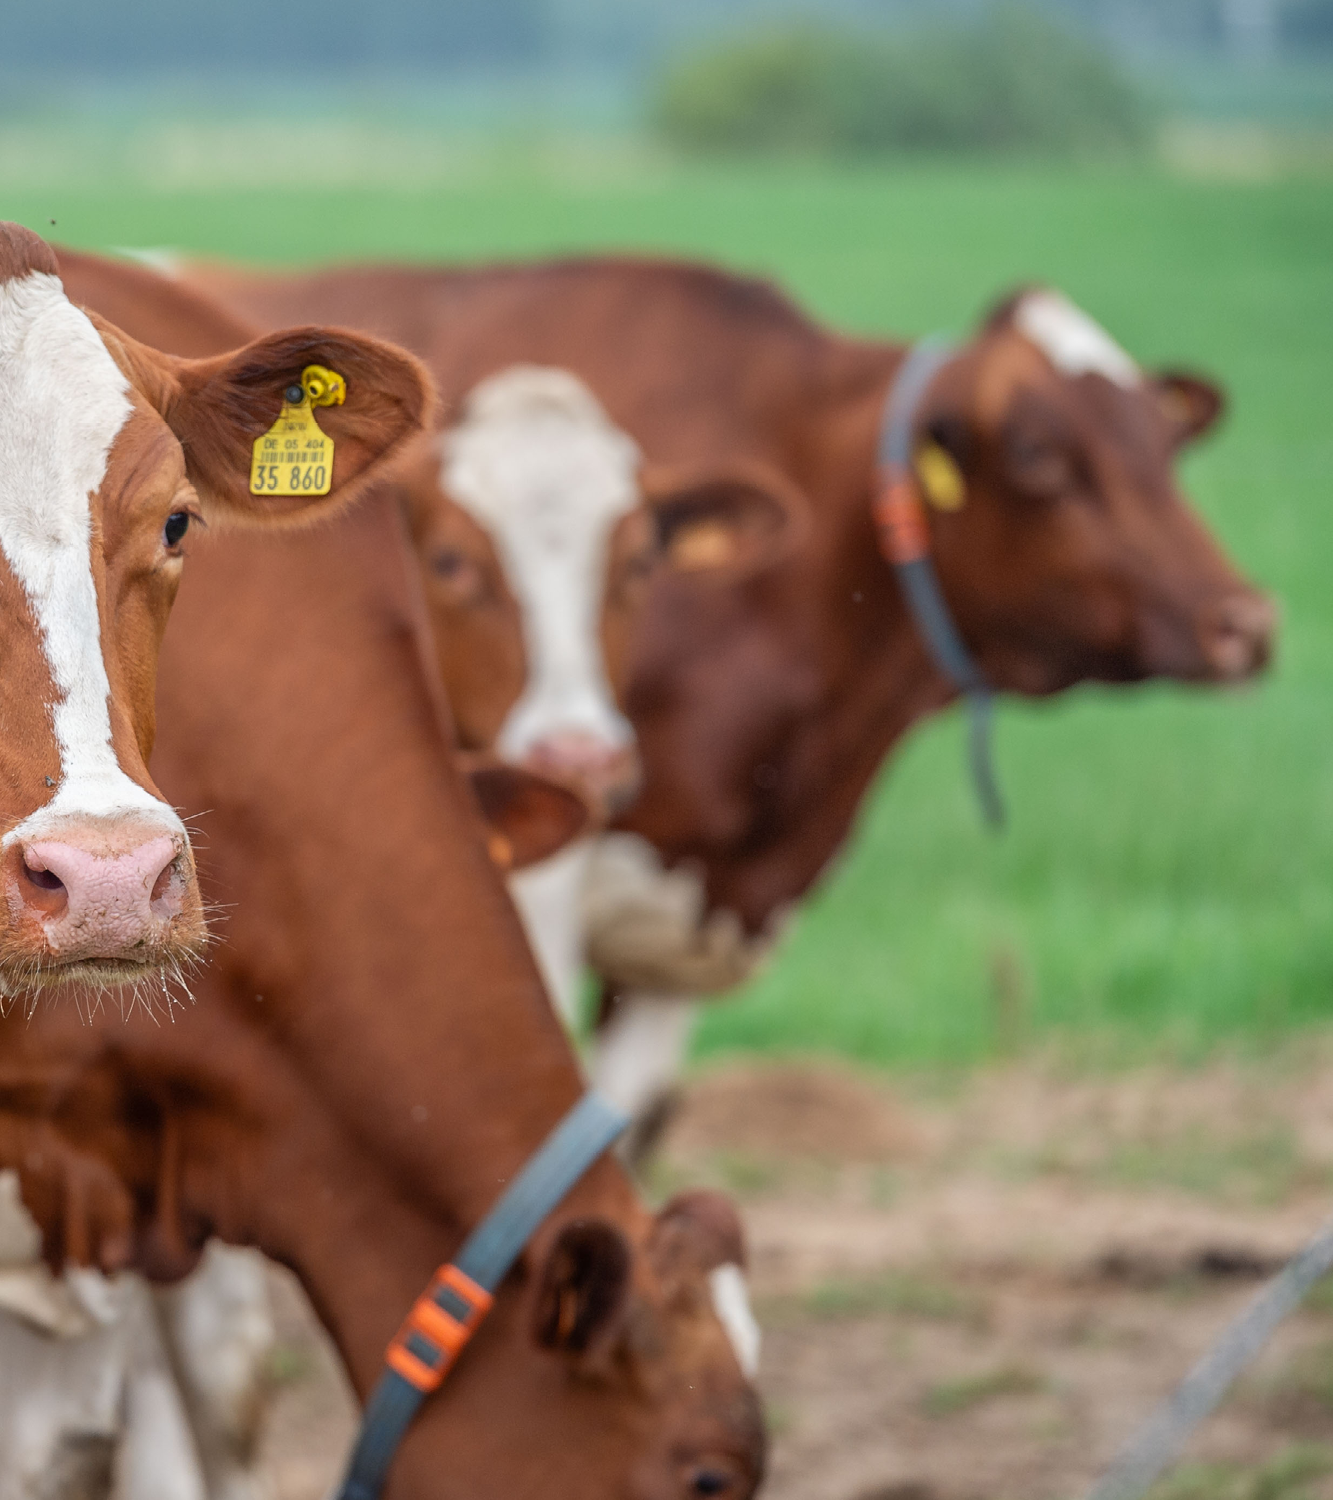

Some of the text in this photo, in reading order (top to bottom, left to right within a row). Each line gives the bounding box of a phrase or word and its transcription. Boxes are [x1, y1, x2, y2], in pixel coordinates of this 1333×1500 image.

[264, 439, 324, 449] DE 05 404
[254, 465, 326, 490] 35 860
